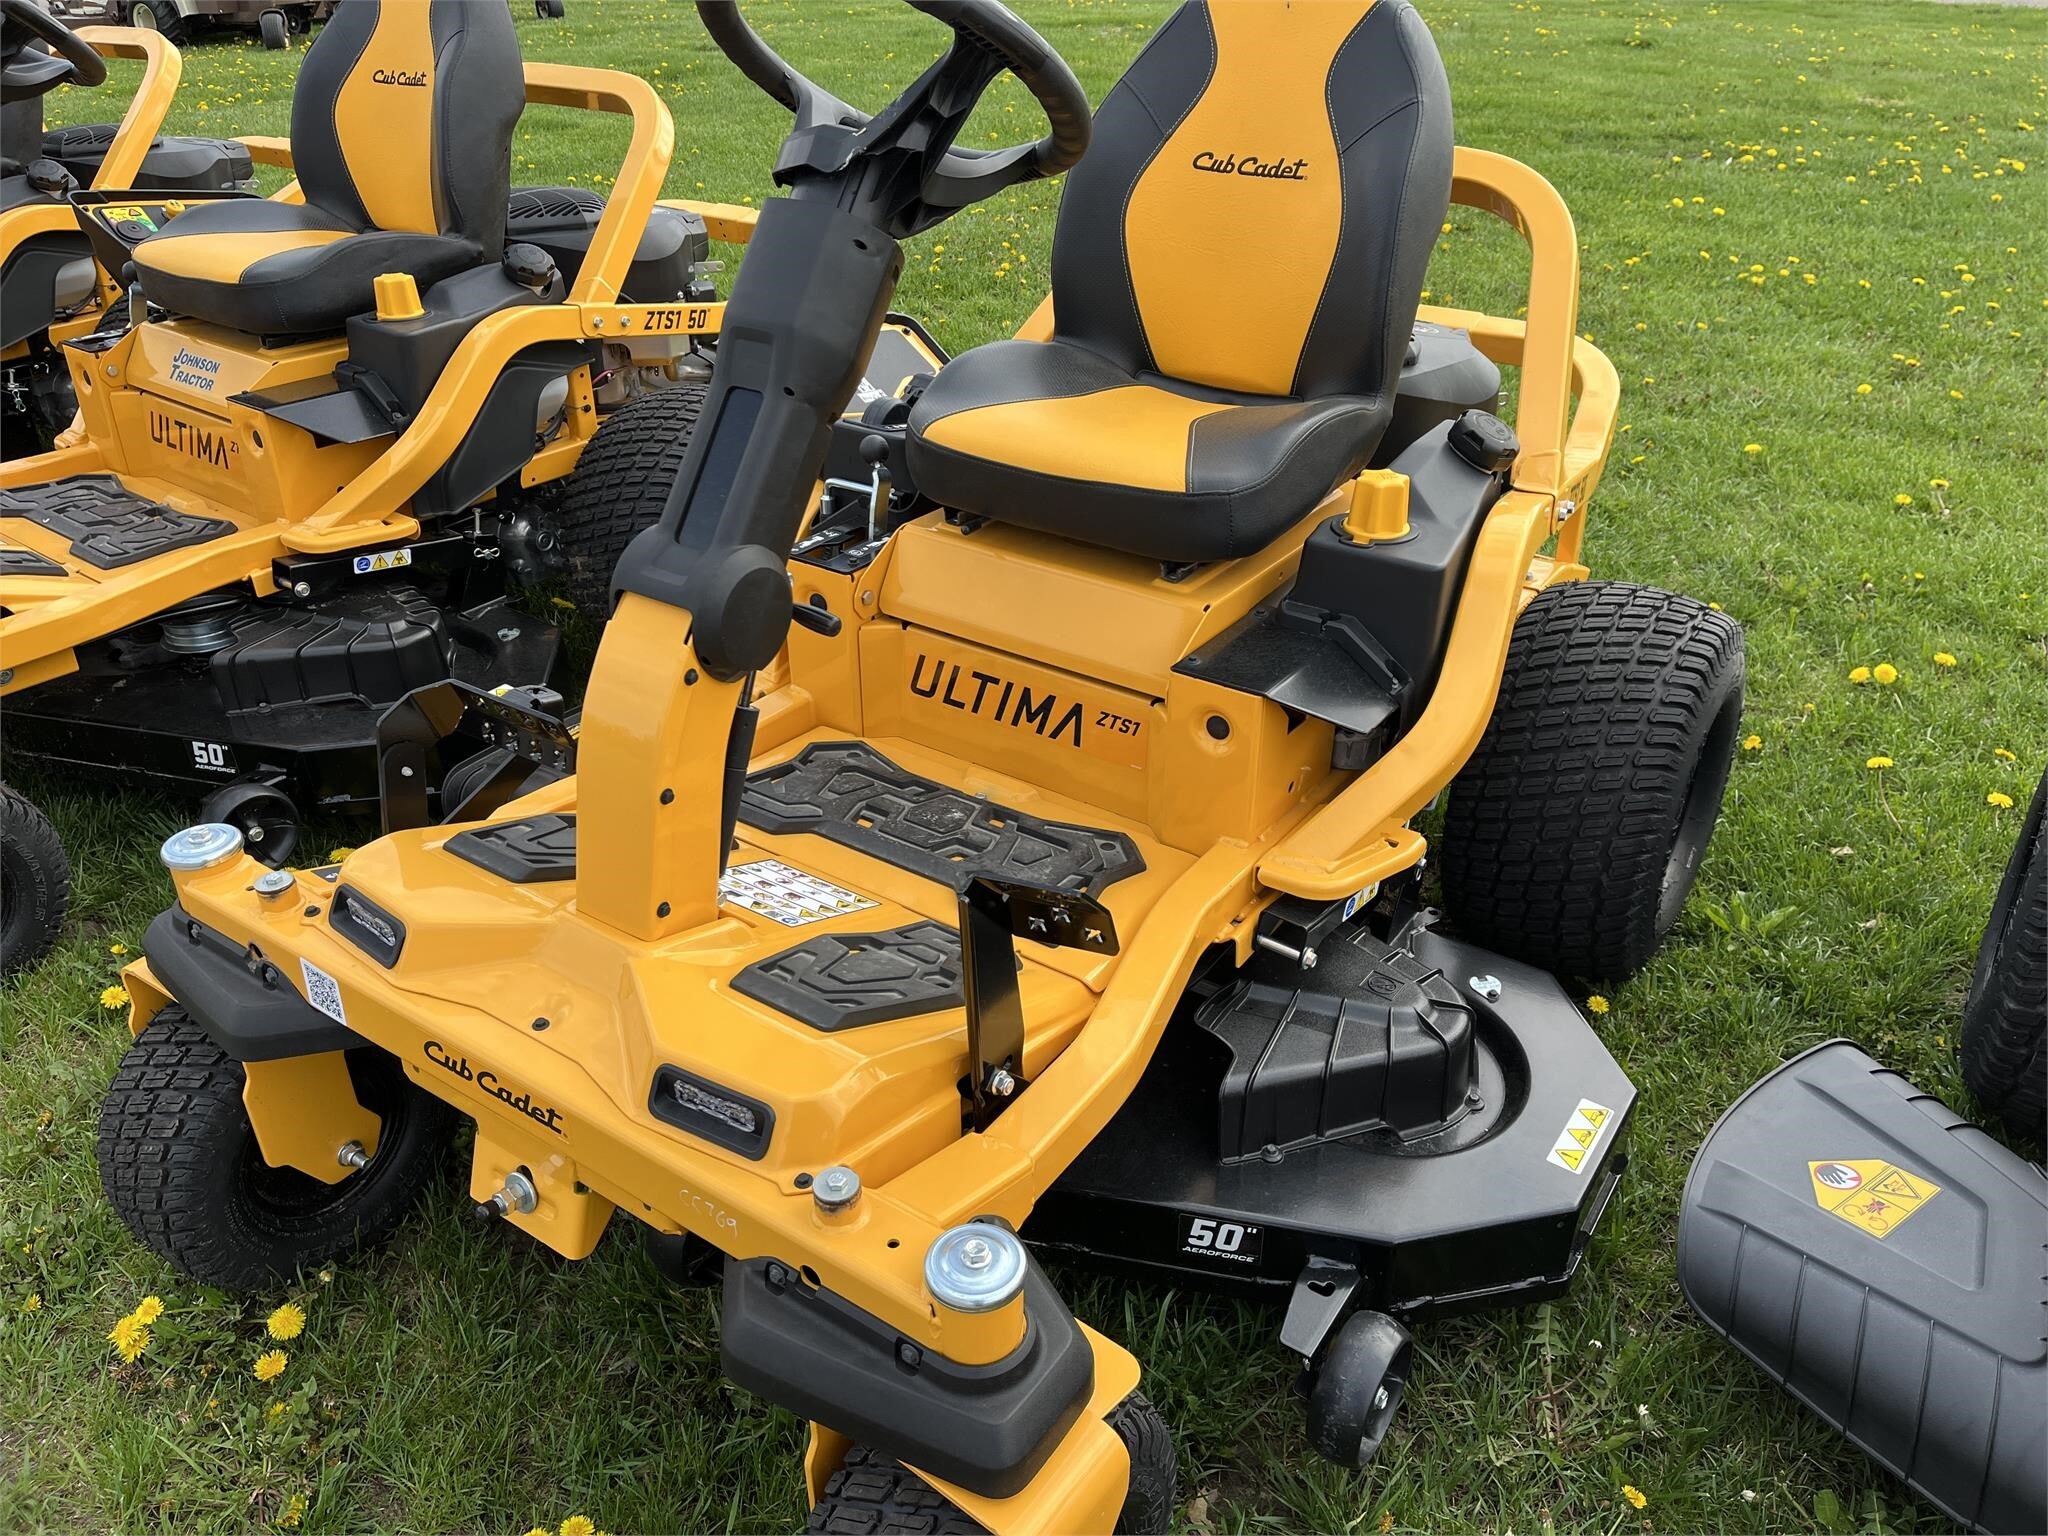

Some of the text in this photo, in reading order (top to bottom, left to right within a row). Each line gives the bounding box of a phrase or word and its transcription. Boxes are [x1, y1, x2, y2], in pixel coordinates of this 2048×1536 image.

[373, 69, 427, 87] Cub Cadet
[1192, 151, 1308, 180] Cub Cadet
[644, 310, 682, 330] ZTS1
[173, 347, 221, 374] JOHNSON
[169, 363, 215, 391] TRACTOR
[150, 410, 229, 470] ULTIMA
[910, 654, 1141, 748] ULTIMA ZTS1
[192, 741, 229, 766] 50"
[423, 1040, 564, 1135] Cub Cadet
[1187, 1218, 1257, 1251] 50"
[1182, 1246, 1255, 1263] AEROFORCE
